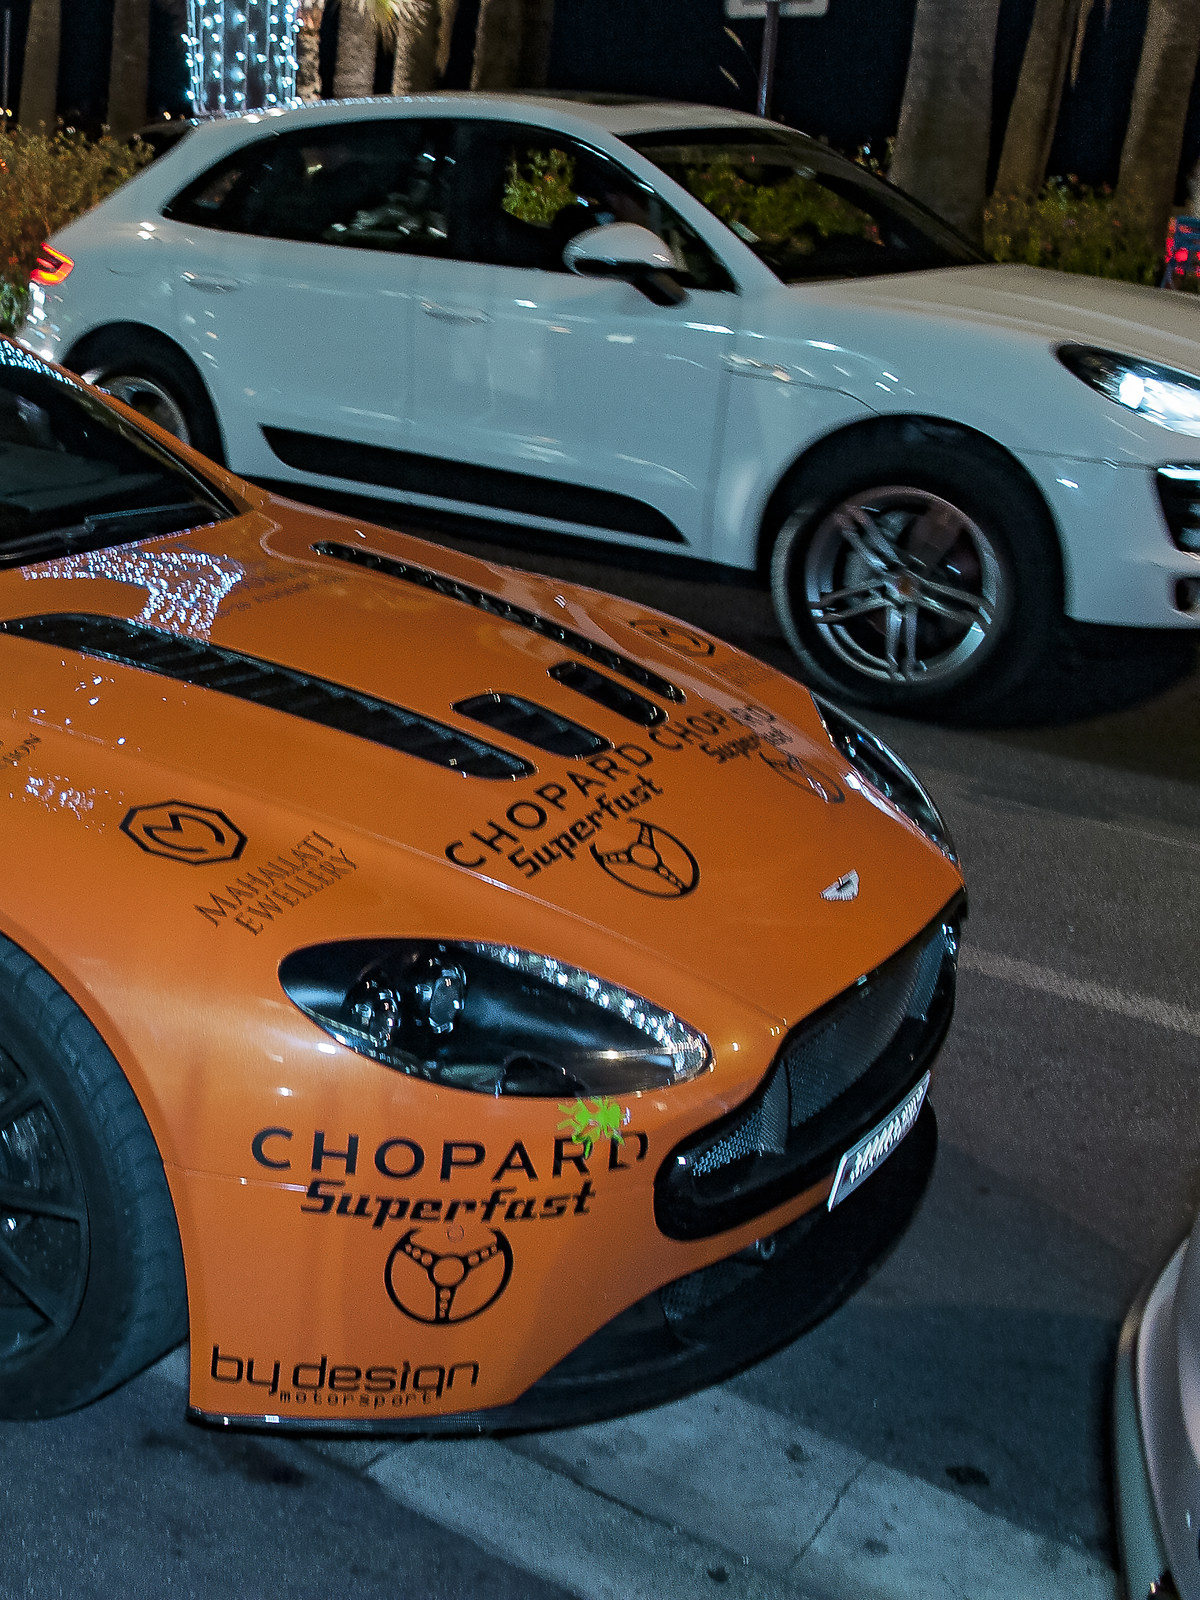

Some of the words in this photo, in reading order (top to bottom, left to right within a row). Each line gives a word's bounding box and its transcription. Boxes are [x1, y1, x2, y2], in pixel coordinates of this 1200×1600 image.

[445, 742, 654, 868] CHOPARD
[507, 774, 664, 878] Superfast
[193, 830, 335, 927] MAHALLATI
[251, 1126, 648, 1182] CHOPARD
[301, 1177, 596, 1229] Superfast
[211, 1345, 280, 1396] by
[292, 1355, 480, 1399] design
[280, 1388, 434, 1409] motorsport
